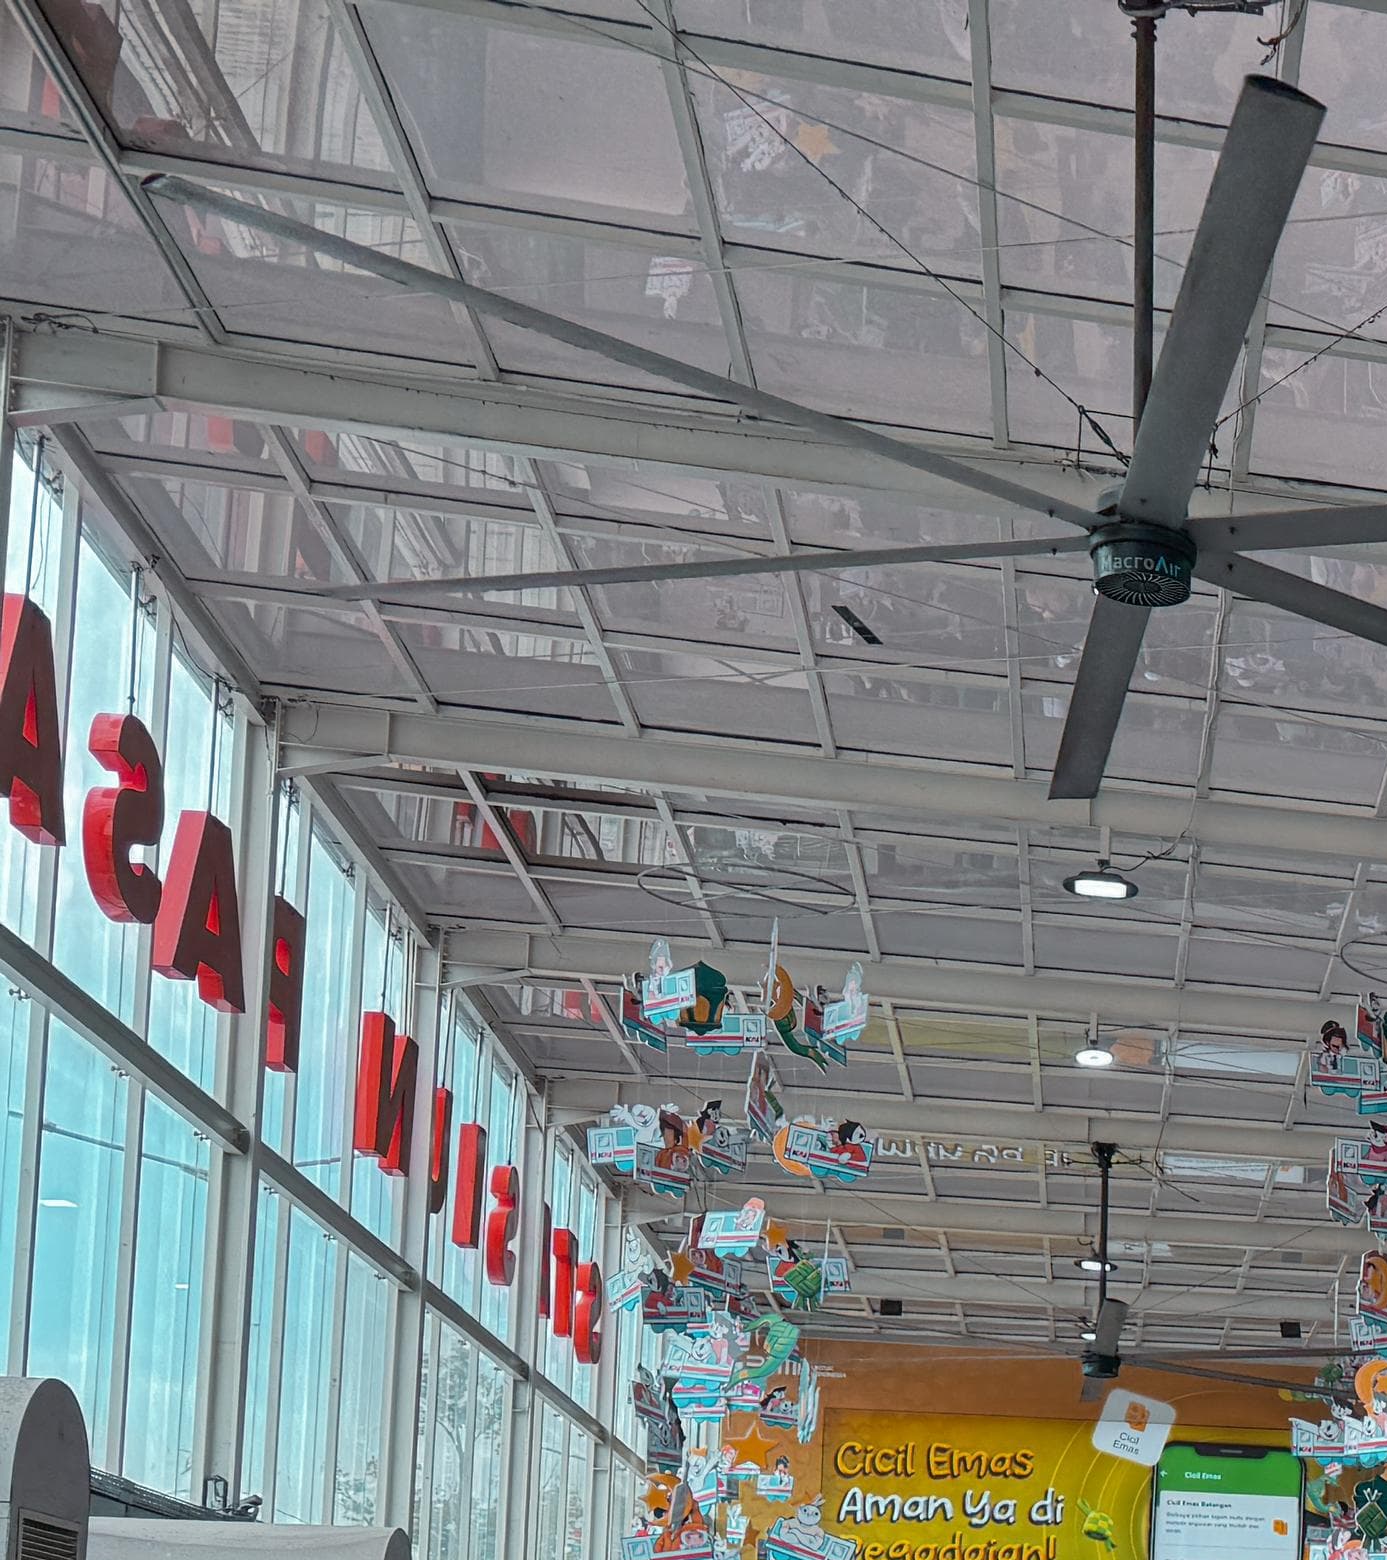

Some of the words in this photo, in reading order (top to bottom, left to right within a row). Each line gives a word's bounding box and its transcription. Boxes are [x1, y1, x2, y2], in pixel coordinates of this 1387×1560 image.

[835, 1441, 916, 1479] Cicil
[926, 1442, 1035, 1480] Emas
[839, 1486, 953, 1524] Aman
[964, 1488, 1018, 1529] Ya
[1029, 1487, 1066, 1525] di
